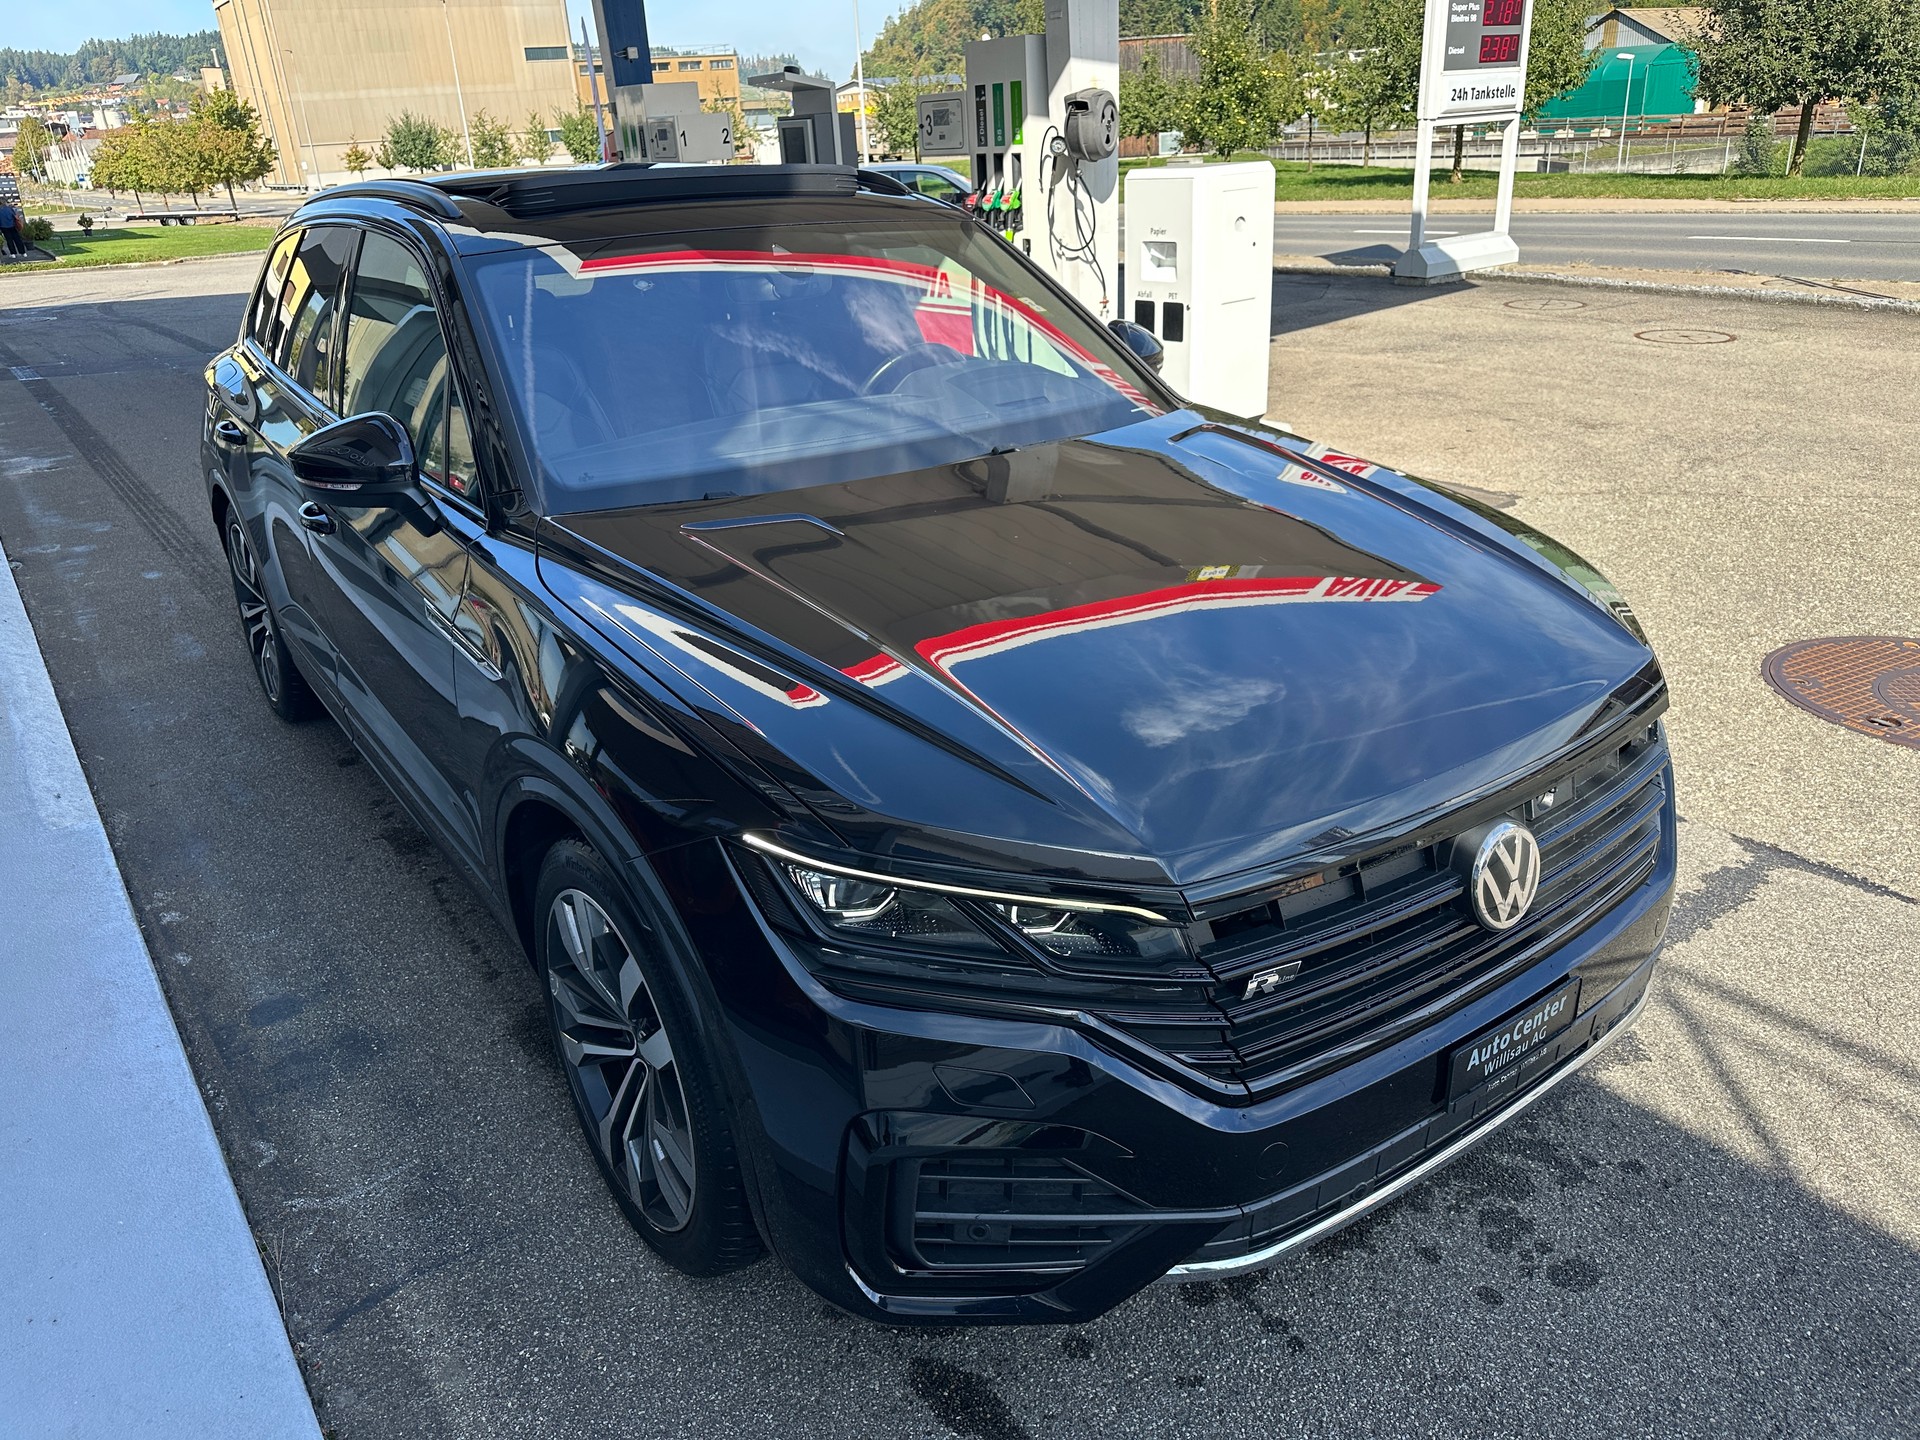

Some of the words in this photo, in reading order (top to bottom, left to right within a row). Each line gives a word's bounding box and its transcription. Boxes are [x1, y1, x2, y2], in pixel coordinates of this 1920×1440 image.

[1452, 3, 1468, 12] Super
[1469, 2, 1480, 11] Plus
[1448, 46, 1465, 54] Diesel
[1451, 87, 1468, 101] 24h
[1471, 84, 1516, 100] Tankstelle
[926, 114, 933, 136] 3
[680, 130, 687, 147] 1
[721, 128, 730, 144] 2
[1150, 228, 1167, 236] Papier
[1137, 290, 1152, 298] Abfall
[1168, 292, 1178, 300] PET
[1484, 1040, 1529, 1076] Willisau
[1530, 1025, 1547, 1047] AG
